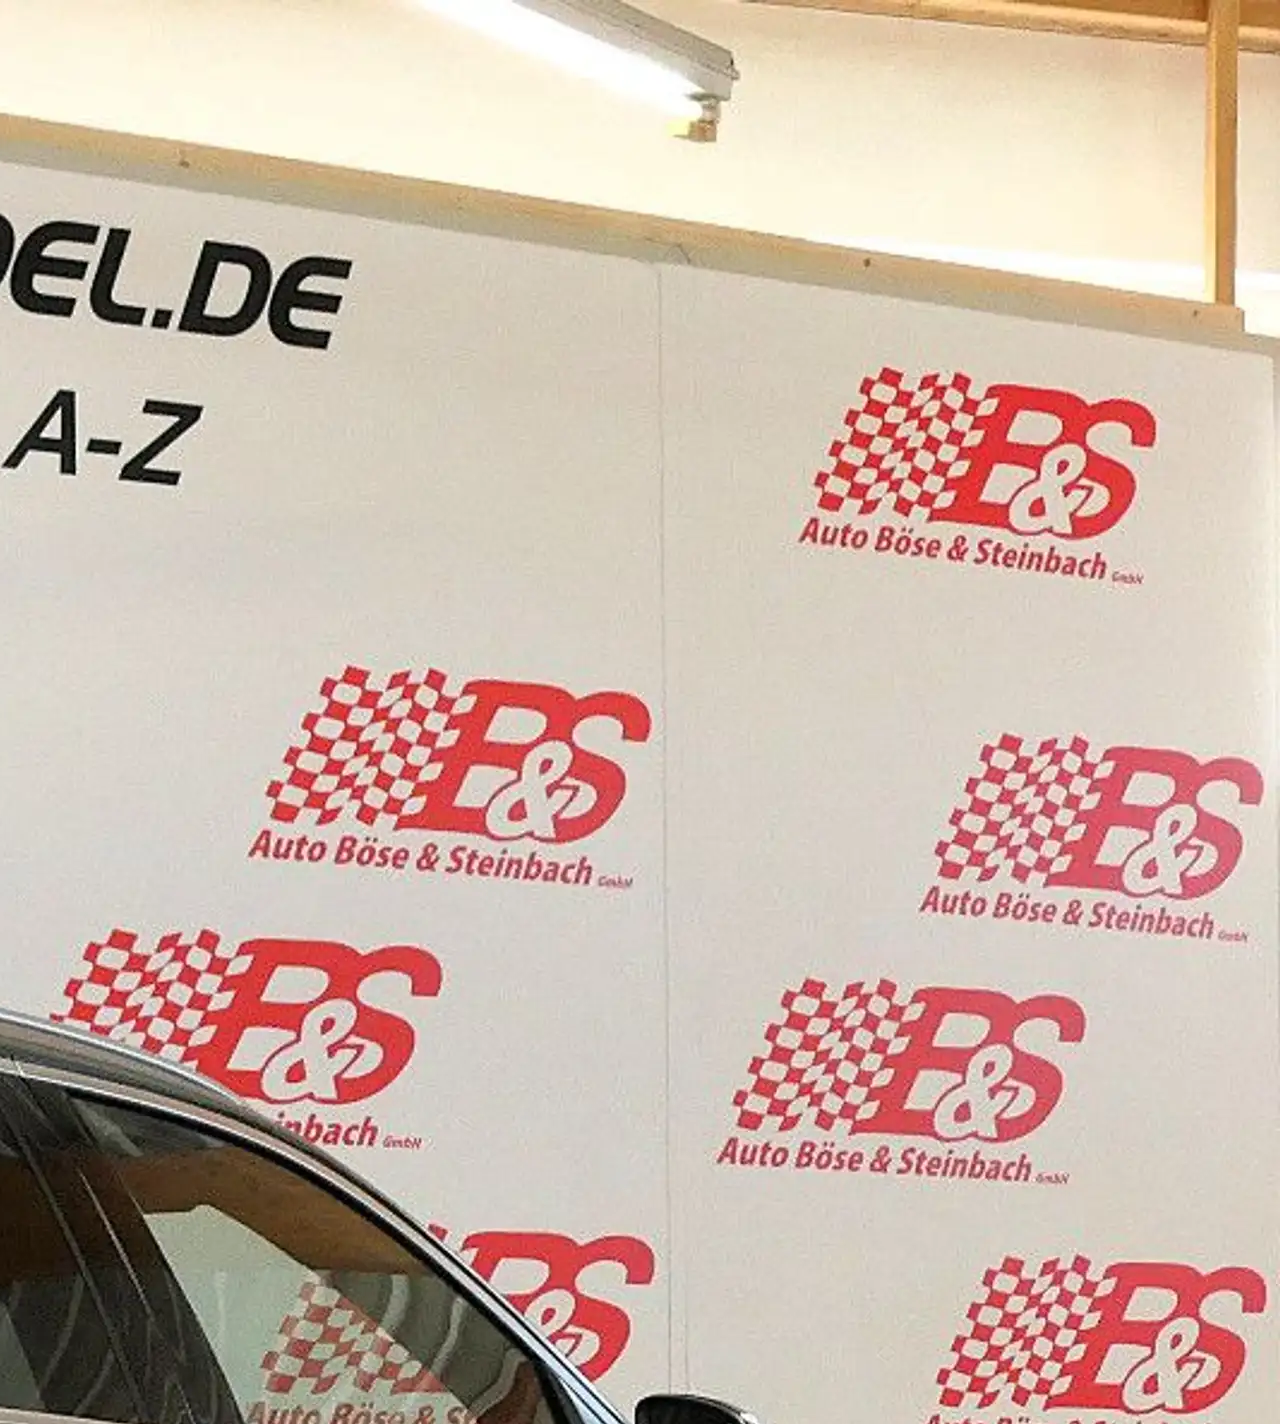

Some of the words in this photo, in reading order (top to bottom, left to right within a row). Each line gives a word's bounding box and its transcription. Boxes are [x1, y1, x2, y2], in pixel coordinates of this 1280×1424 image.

[3, 390, 203, 486] A-Z
[928, 384, 1157, 540] B&S
[798, 515, 872, 552] Auto
[873, 523, 944, 562] Böse
[945, 534, 969, 564] &
[974, 536, 1109, 580] Steinbach
[394, 680, 651, 844] B&S
[1044, 746, 1264, 900] B&S
[249, 827, 328, 862] Auto
[334, 834, 411, 870] Böse
[414, 843, 440, 874] &
[444, 844, 593, 885] Steinbach
[922, 885, 989, 919] Auto
[990, 890, 1059, 926] Böse
[1061, 899, 1084, 925] &
[1088, 899, 1217, 942] Steinbach
[198, 938, 442, 1104] B&S
[849, 987, 1085, 1143] B&S
[715, 1136, 790, 1168] Auto
[794, 1140, 866, 1175] Böse
[867, 1146, 892, 1175] &
[898, 1146, 1034, 1185] Steinbach
[1043, 1262, 1266, 1415] B&S
